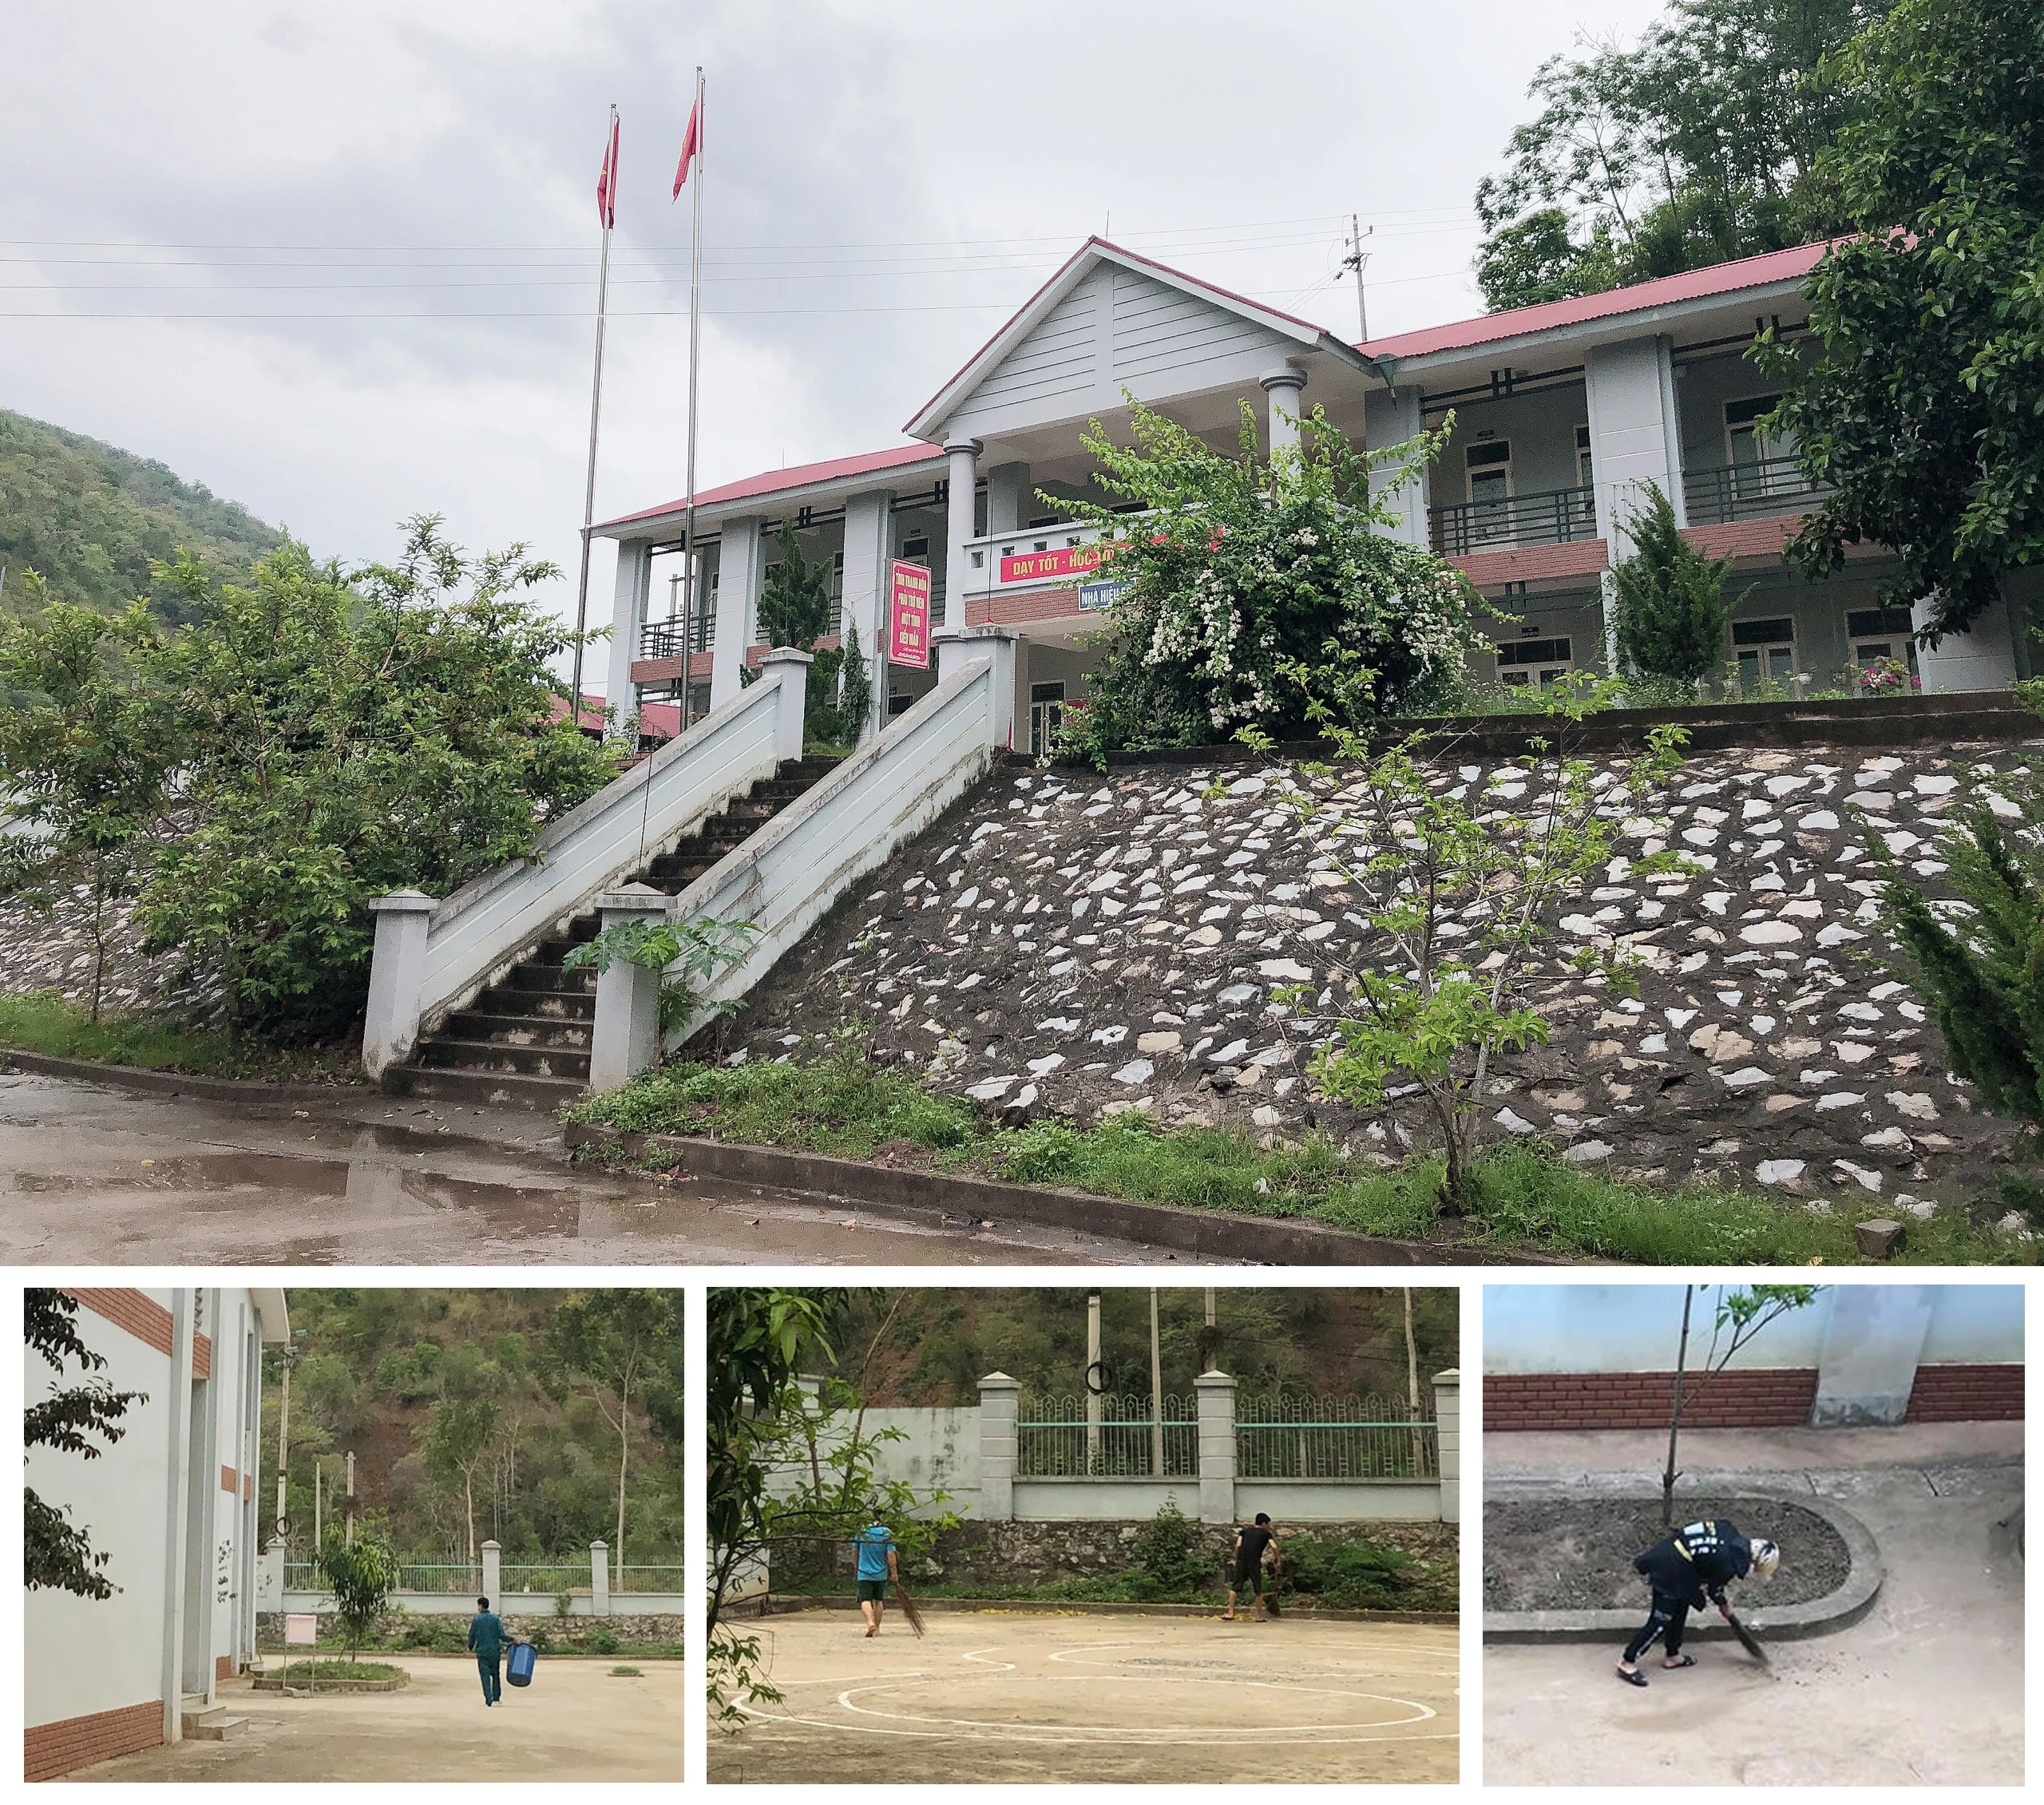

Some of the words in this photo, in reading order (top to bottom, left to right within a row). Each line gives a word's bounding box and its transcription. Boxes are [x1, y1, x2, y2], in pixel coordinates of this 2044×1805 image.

[1013, 560, 1034, 576] DẠY
[1038, 554, 1059, 572] TỐT
[1069, 551, 1091, 569] HỌC
[1081, 588, 1099, 605] NHÀ
